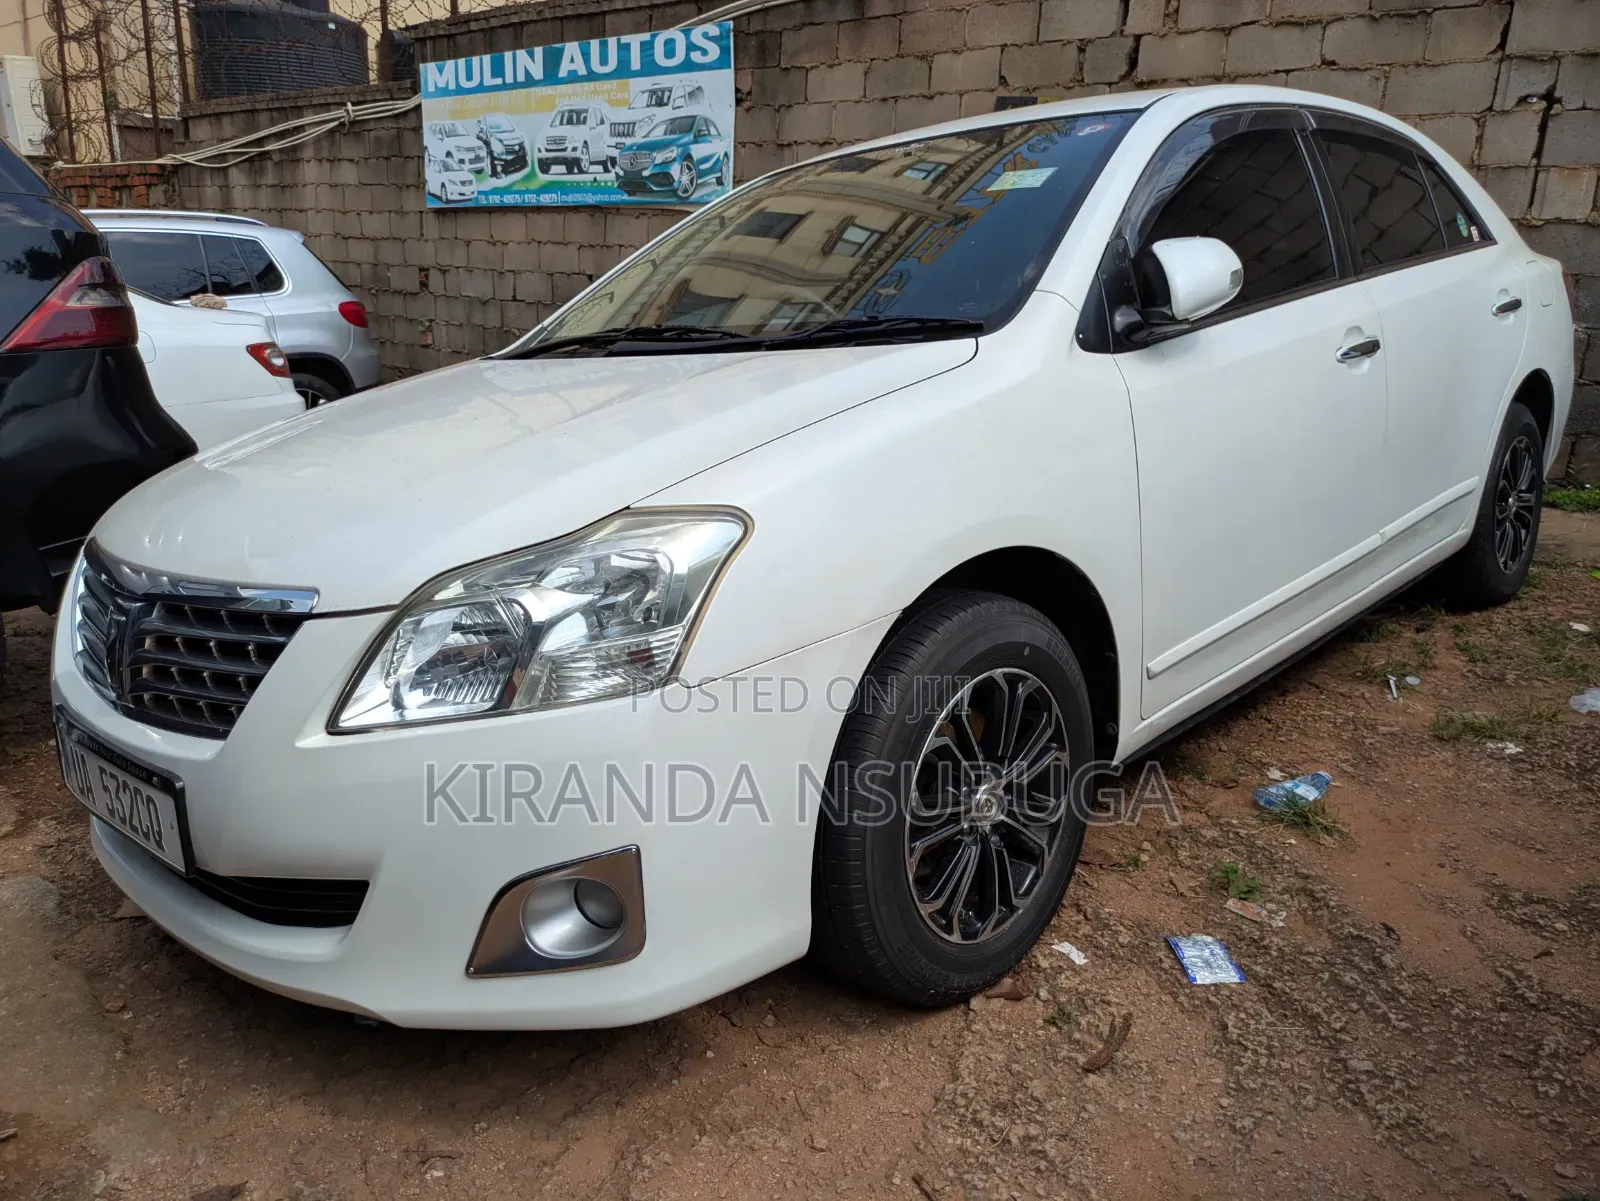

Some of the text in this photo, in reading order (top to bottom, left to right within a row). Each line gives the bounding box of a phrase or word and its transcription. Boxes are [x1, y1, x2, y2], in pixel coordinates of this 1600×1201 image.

[427, 26, 721, 92] MULIN AUTOS
[98, 764, 168, 853] 532CQ
